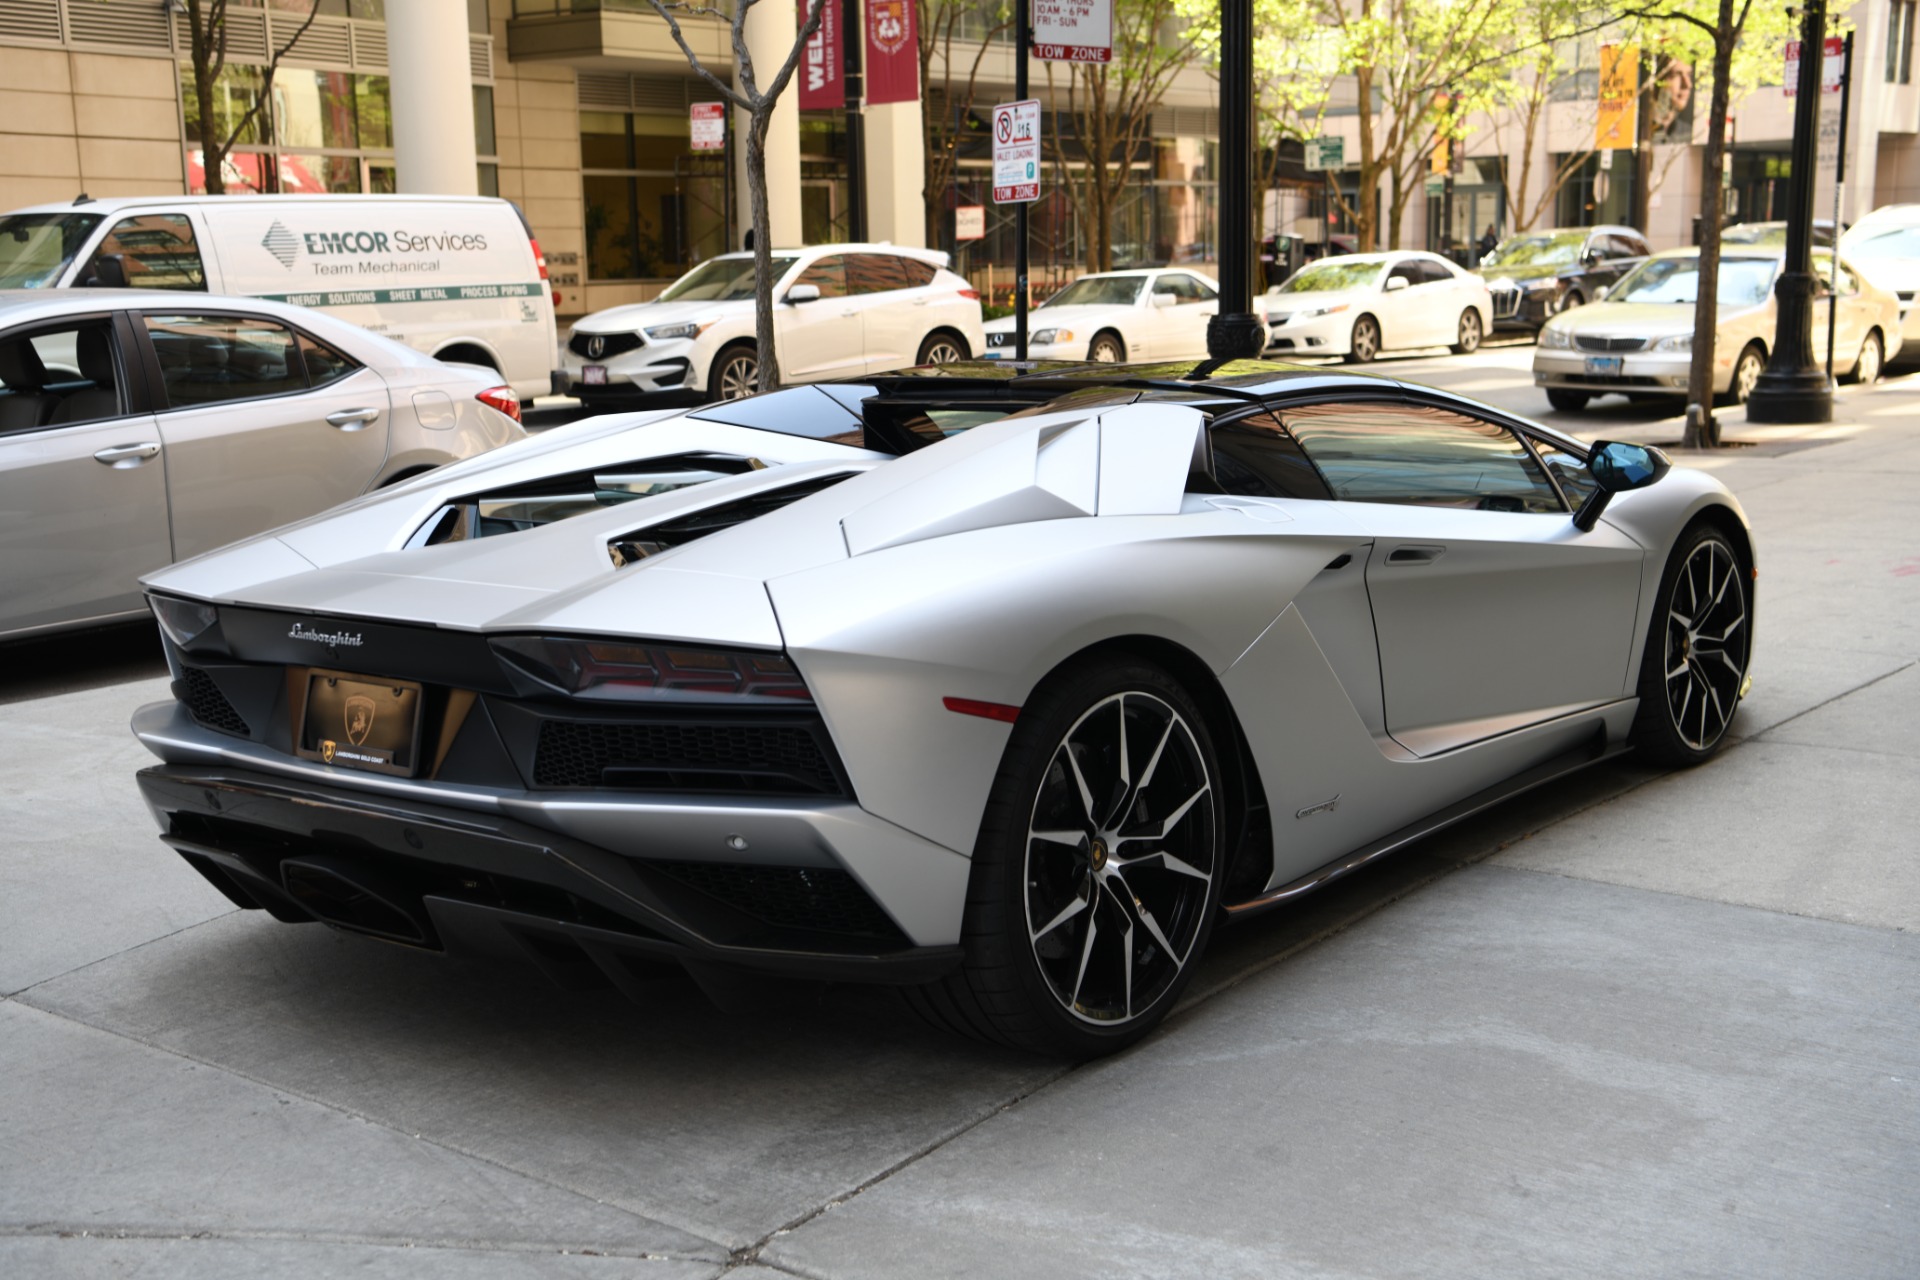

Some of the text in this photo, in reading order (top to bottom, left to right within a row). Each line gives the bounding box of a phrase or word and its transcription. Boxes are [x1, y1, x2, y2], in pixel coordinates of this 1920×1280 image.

[1037, 4, 1045, 14] 10
[1047, 5, 1060, 15] AM
[1069, 6, 1076, 16] 6
[1077, 7, 1090, 17] PM
[825, 7, 834, 43] TOWER
[1036, 15, 1051, 25] FRI
[1059, 17, 1078, 27] SUN
[1037, 45, 1106, 60] TOW ZONE
[826, 46, 835, 82] WATER
[996, 148, 1035, 162] VALET LOADING
[996, 184, 1035, 201] TOW ZONE
[303, 230, 487, 255] EMCOR Services
[312, 260, 440, 275] Team Mechanical
[286, 284, 528, 305] ENERGY SOLUTIONS SHEET METAL PROCESS PIPING
[288, 622, 364, 647] Lamborghini
